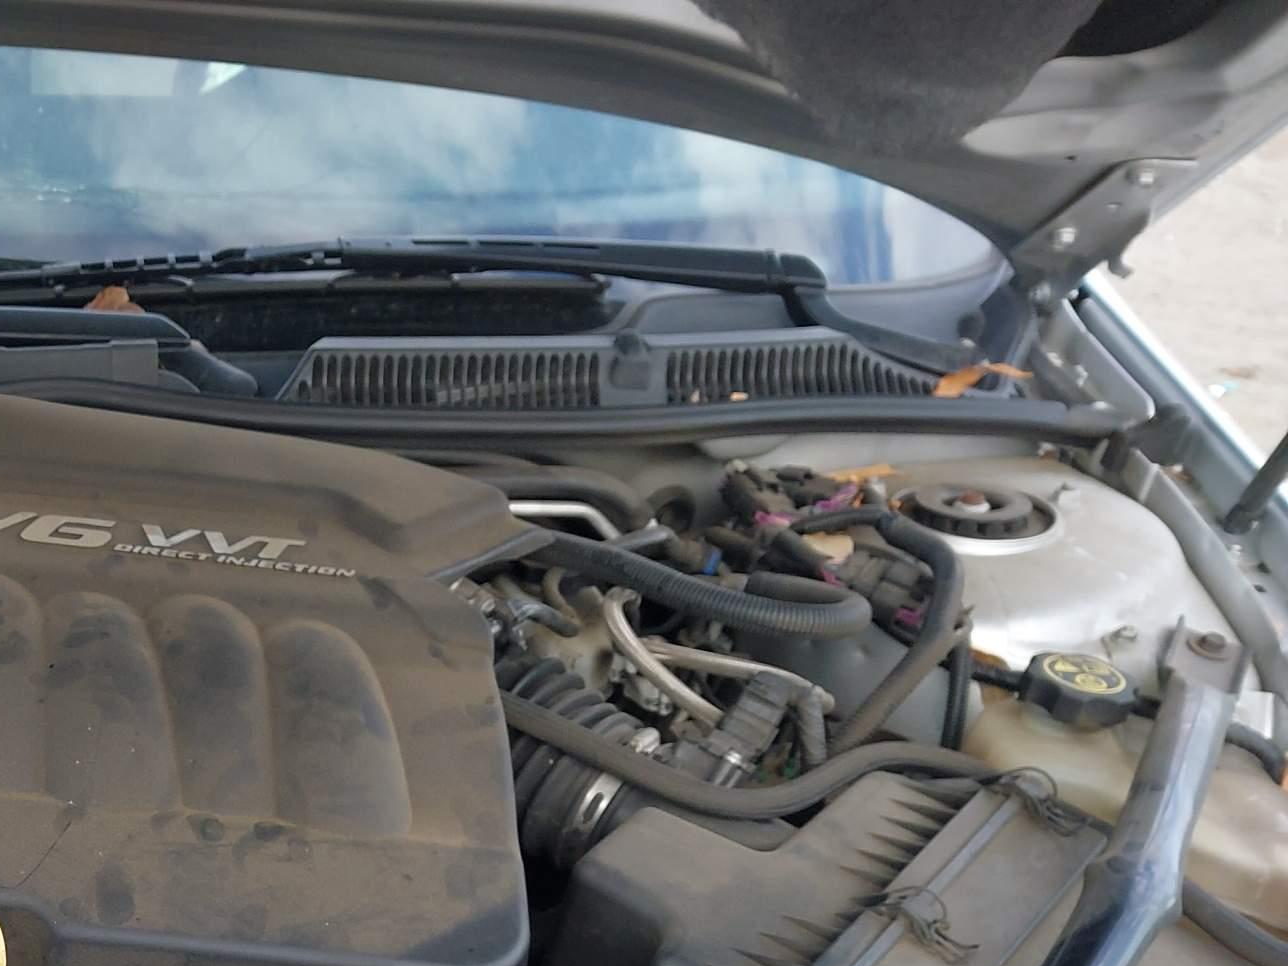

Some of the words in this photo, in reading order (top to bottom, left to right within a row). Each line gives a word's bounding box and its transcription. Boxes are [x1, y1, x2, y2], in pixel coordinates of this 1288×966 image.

[142, 523, 307, 560] VVT
[114, 543, 212, 562] DIRECT
[216, 554, 357, 578] INJECTION
